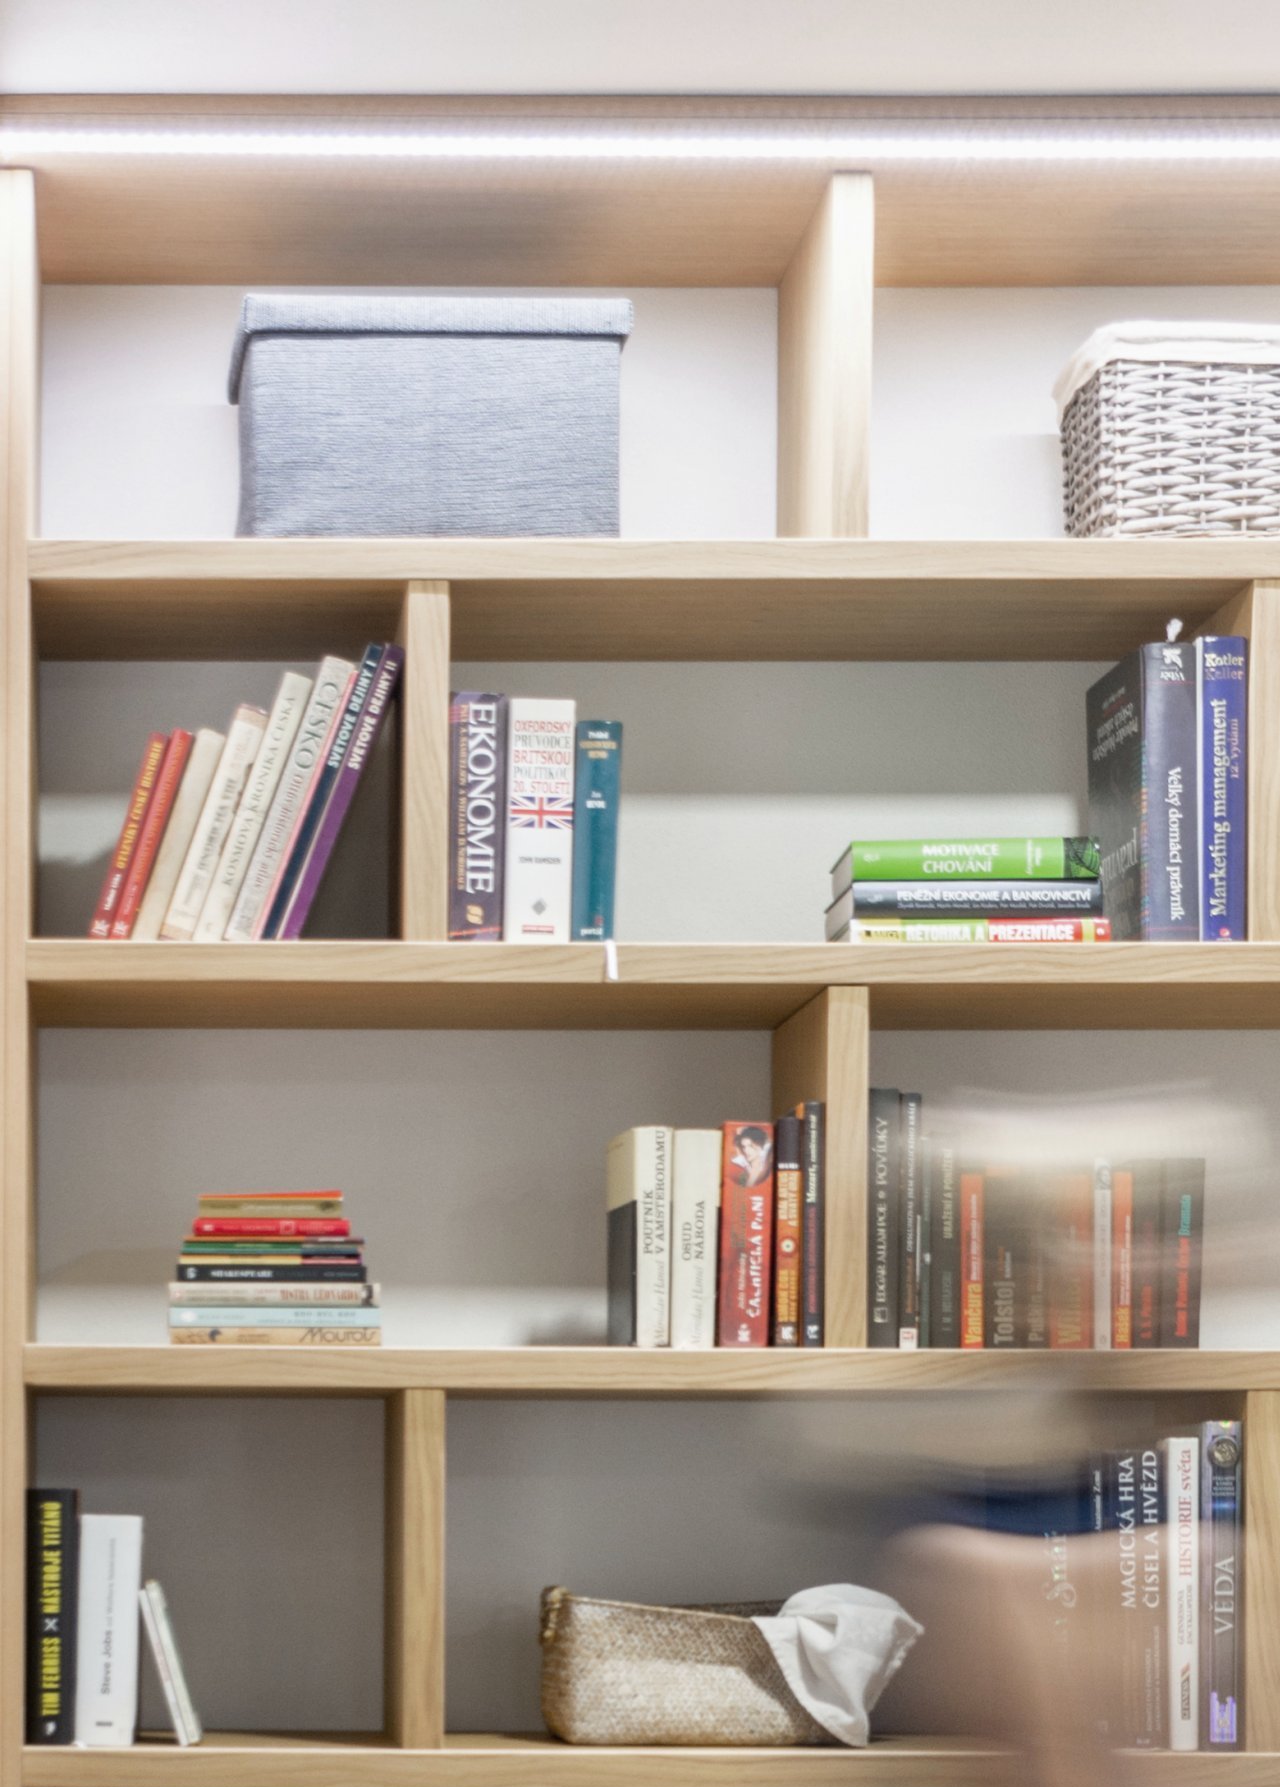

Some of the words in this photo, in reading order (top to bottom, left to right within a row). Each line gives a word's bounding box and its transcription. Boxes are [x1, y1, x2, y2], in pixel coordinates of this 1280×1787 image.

[1205, 653, 1244, 668] Kotler
[1205, 668, 1244, 681] Keller
[249, 747, 277, 813] KRONIKA
[513, 750, 570, 765] BRITSKOU
[1210, 698, 1229, 817] management
[466, 702, 497, 894] EKONOMIE
[1167, 767, 1183, 804] Velký
[922, 844, 999, 857] MOTIVACE
[1165, 807, 1183, 861] domácí
[923, 856, 993, 874] CHOVÁNÍ
[1208, 821, 1229, 916] Marketing
[941, 890, 998, 901] EKONOMIE
[1001, 891, 1010, 901] A
[1012, 888, 1092, 901] BANKOVNICTVÍ
[1166, 866, 1183, 919] právník
[988, 923, 1075, 941] PREZENTACE
[872, 1117, 888, 1184] POVÍDKY
[655, 1130, 665, 1242] AMSTERODAMU
[643, 1190, 654, 1255] POUTNÍK
[693, 1200, 705, 1260] NÁRODA
[876, 1203, 887, 1226] POE
[656, 1247, 663, 1256] V
[682, 1221, 691, 1261] OSUD
[875, 1228, 887, 1262] ALLAN
[875, 1264, 887, 1302] EDGAR
[963, 1283, 982, 1344] Vančura
[993, 1280, 1015, 1344] Tolstoj
[1118, 1457, 1134, 1501] HRA
[1138, 1450, 1157, 1522] HVĚZD
[1177, 1448, 1191, 1490] světa
[1117, 1508, 1136, 1608] MAGICKÁ
[1143, 1530, 1158, 1544] A
[1178, 1496, 1192, 1577] HISTORIE
[1140, 1550, 1159, 1608] ČÍSEL
[1209, 1555, 1235, 1635] VĚDA
[41, 1692, 60, 1715] TIM
